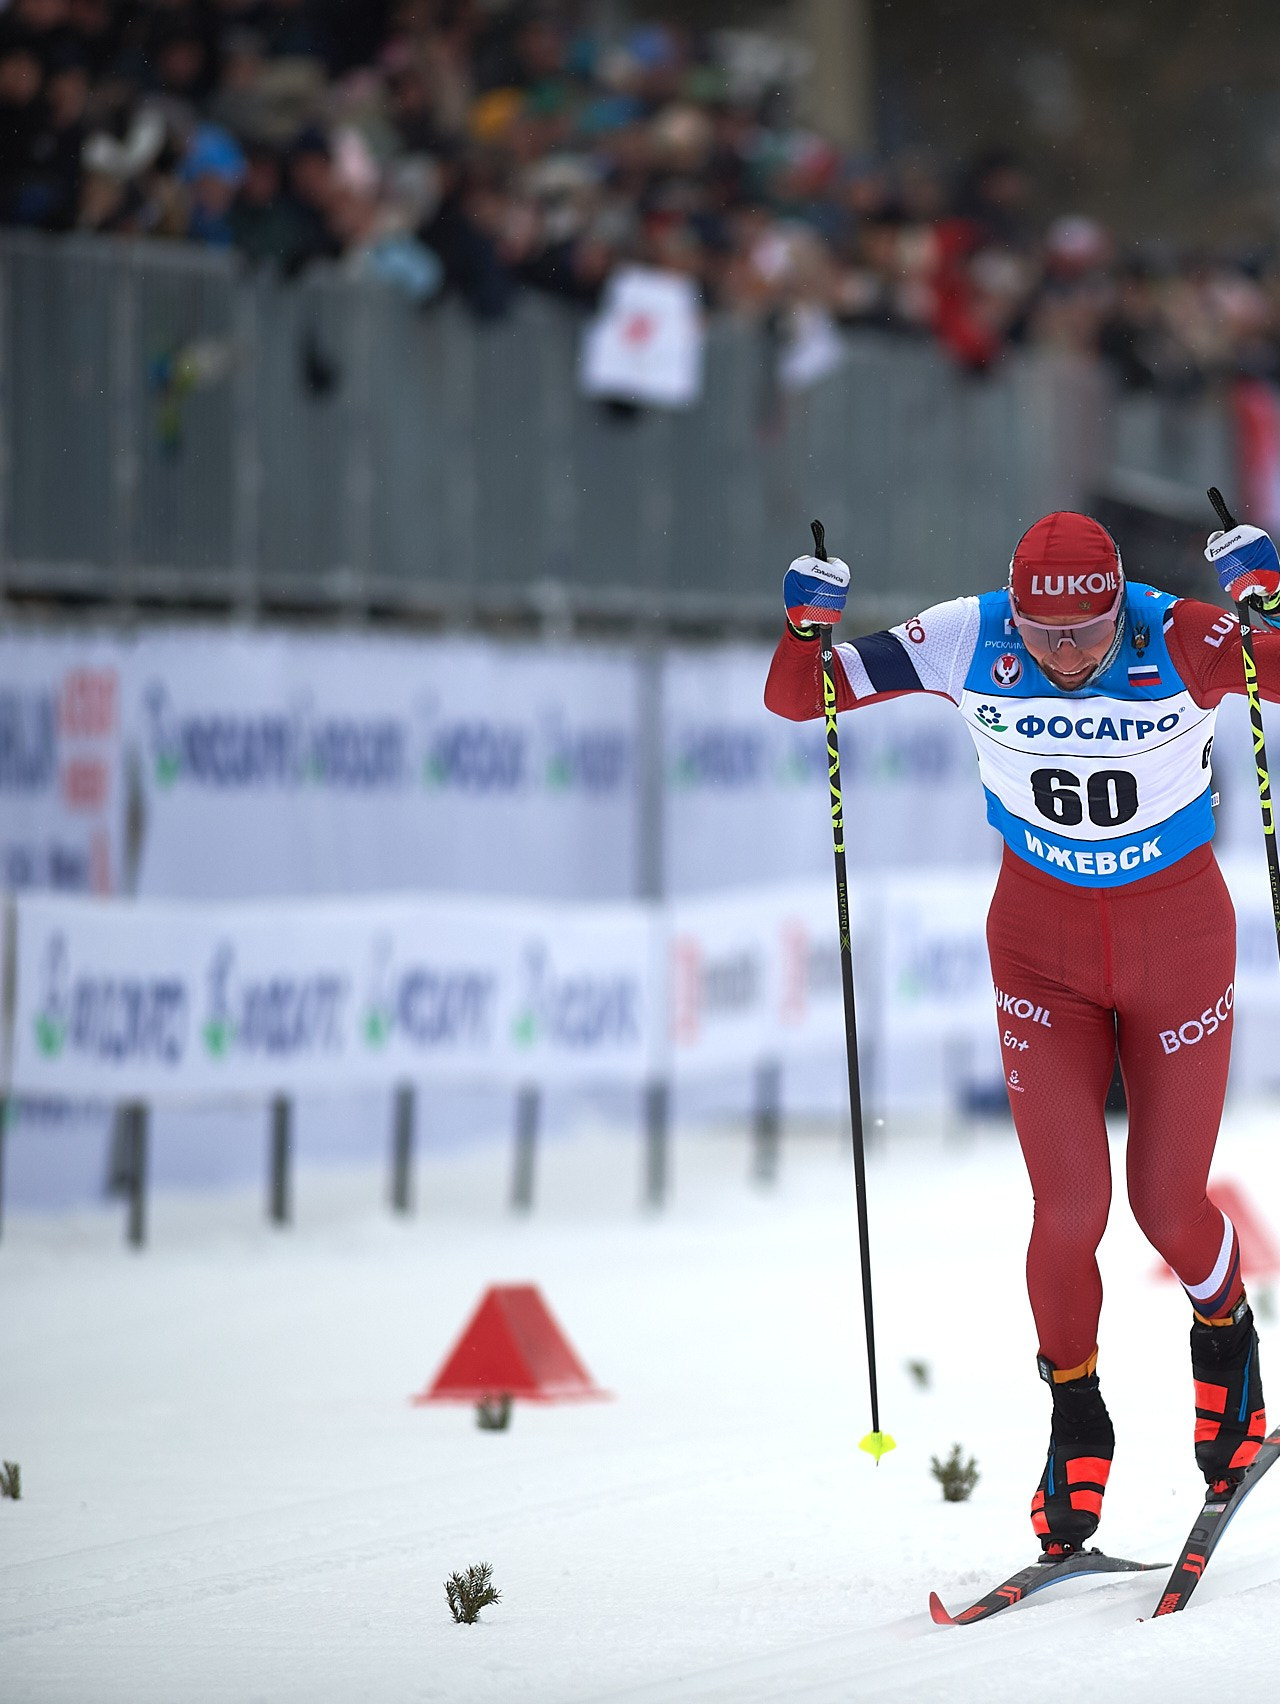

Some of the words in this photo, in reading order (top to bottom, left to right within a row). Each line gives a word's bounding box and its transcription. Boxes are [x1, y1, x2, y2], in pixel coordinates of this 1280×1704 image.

[1031, 571, 1117, 596] LUKOIL
[984, 640, 1026, 650] РУСКЛИМ
[1203, 611, 1241, 649] LUK
[1015, 712, 1180, 741] ФОСАГРО
[1201, 735, 1214, 770] 6
[1030, 768, 1139, 827] 60
[1024, 829, 1163, 876] ИЖЕВСК
[995, 986, 1052, 1028] UKOIL
[1158, 982, 1234, 1055] BOSCO
